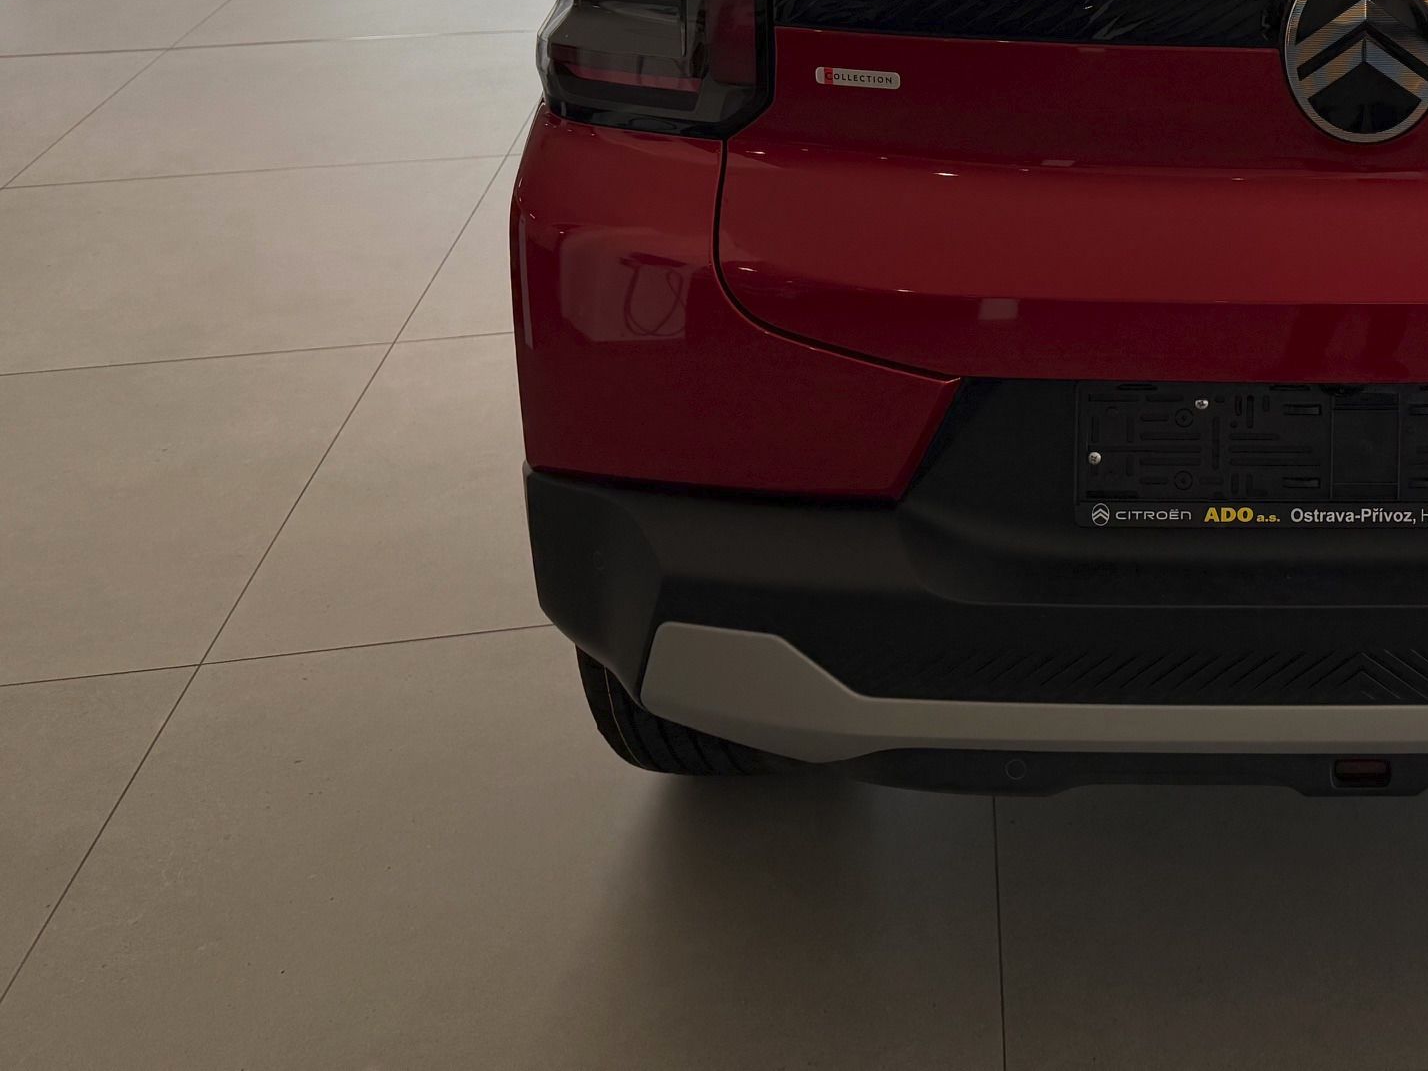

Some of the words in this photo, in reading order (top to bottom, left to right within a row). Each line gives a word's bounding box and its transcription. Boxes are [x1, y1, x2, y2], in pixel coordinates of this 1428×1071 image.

[824, 72, 893, 85] COLLECTION
[1115, 508, 1192, 520] CITROËN
[1203, 506, 1254, 523] ADO
[1256, 514, 1281, 523] a.s.
[1290, 507, 1417, 525] Ostrava-Přívoz,
